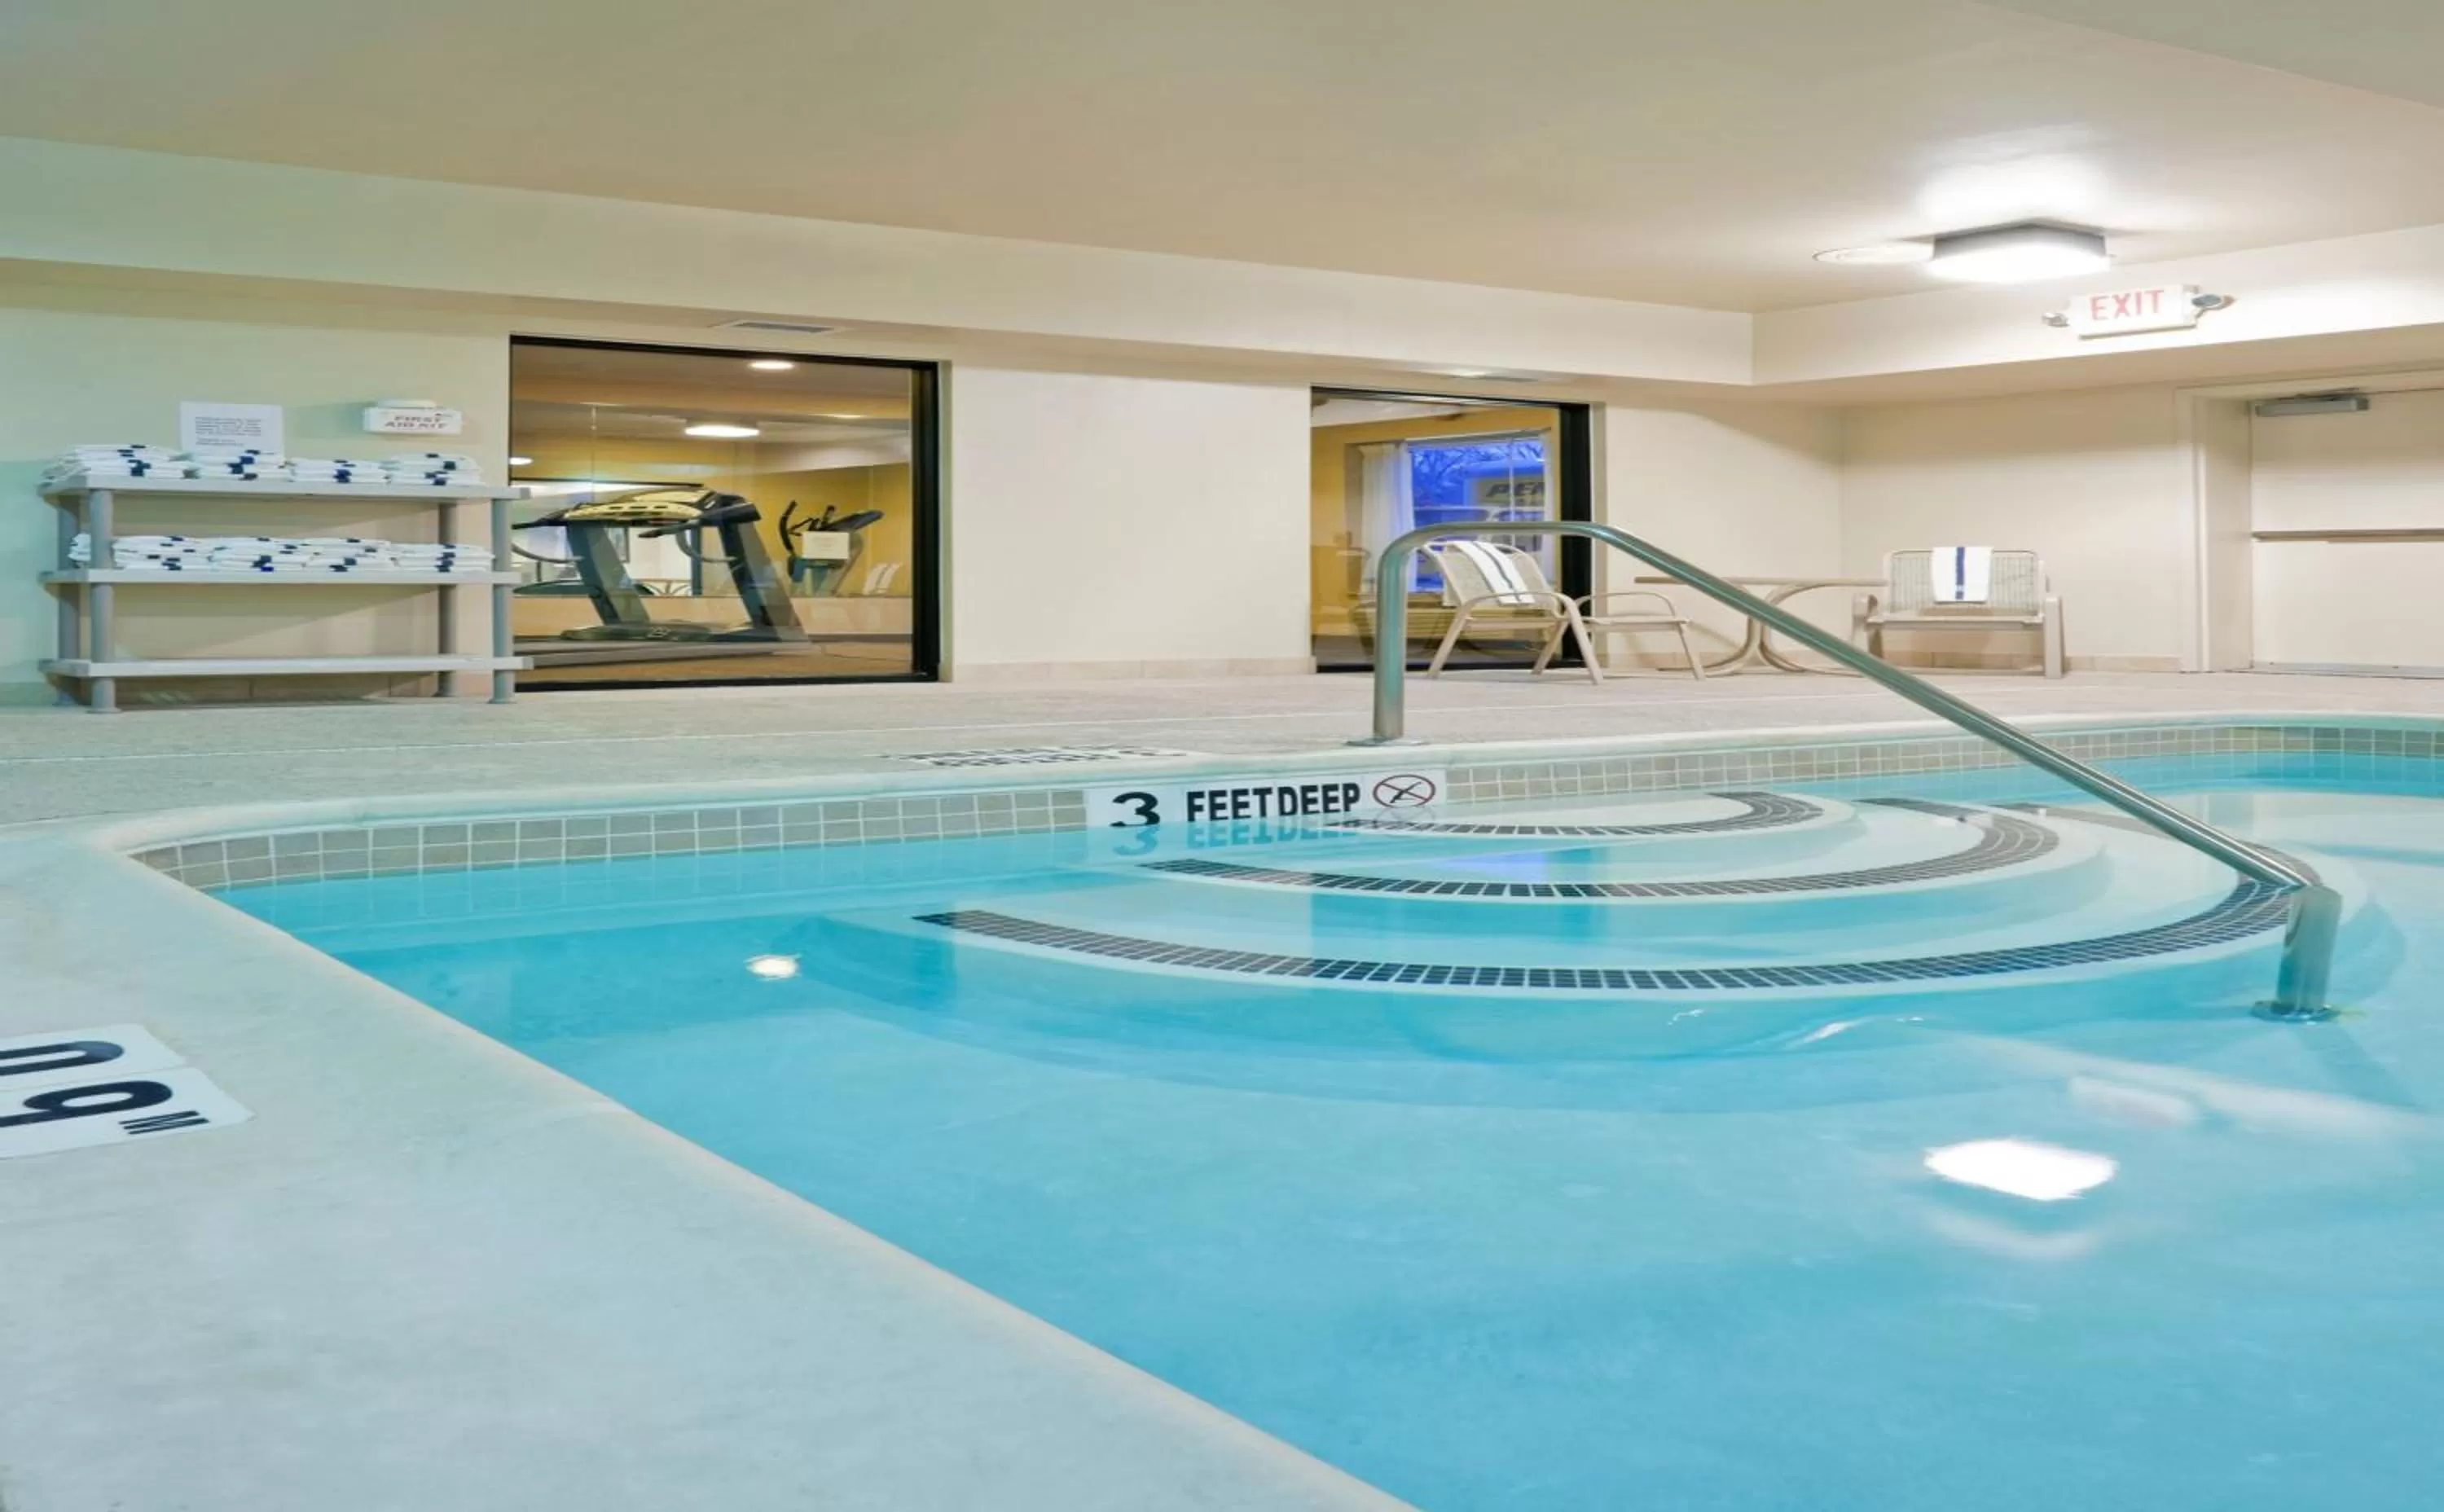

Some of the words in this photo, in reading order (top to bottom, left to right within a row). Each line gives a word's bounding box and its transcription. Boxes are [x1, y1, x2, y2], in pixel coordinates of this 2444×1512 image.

[2089, 289, 2165, 320] EXIT
[393, 415, 442, 424] FIRST
[1110, 791, 1161, 827] 3
[1186, 787, 1273, 822] FEET
[1277, 782, 1361, 815] DEEP
